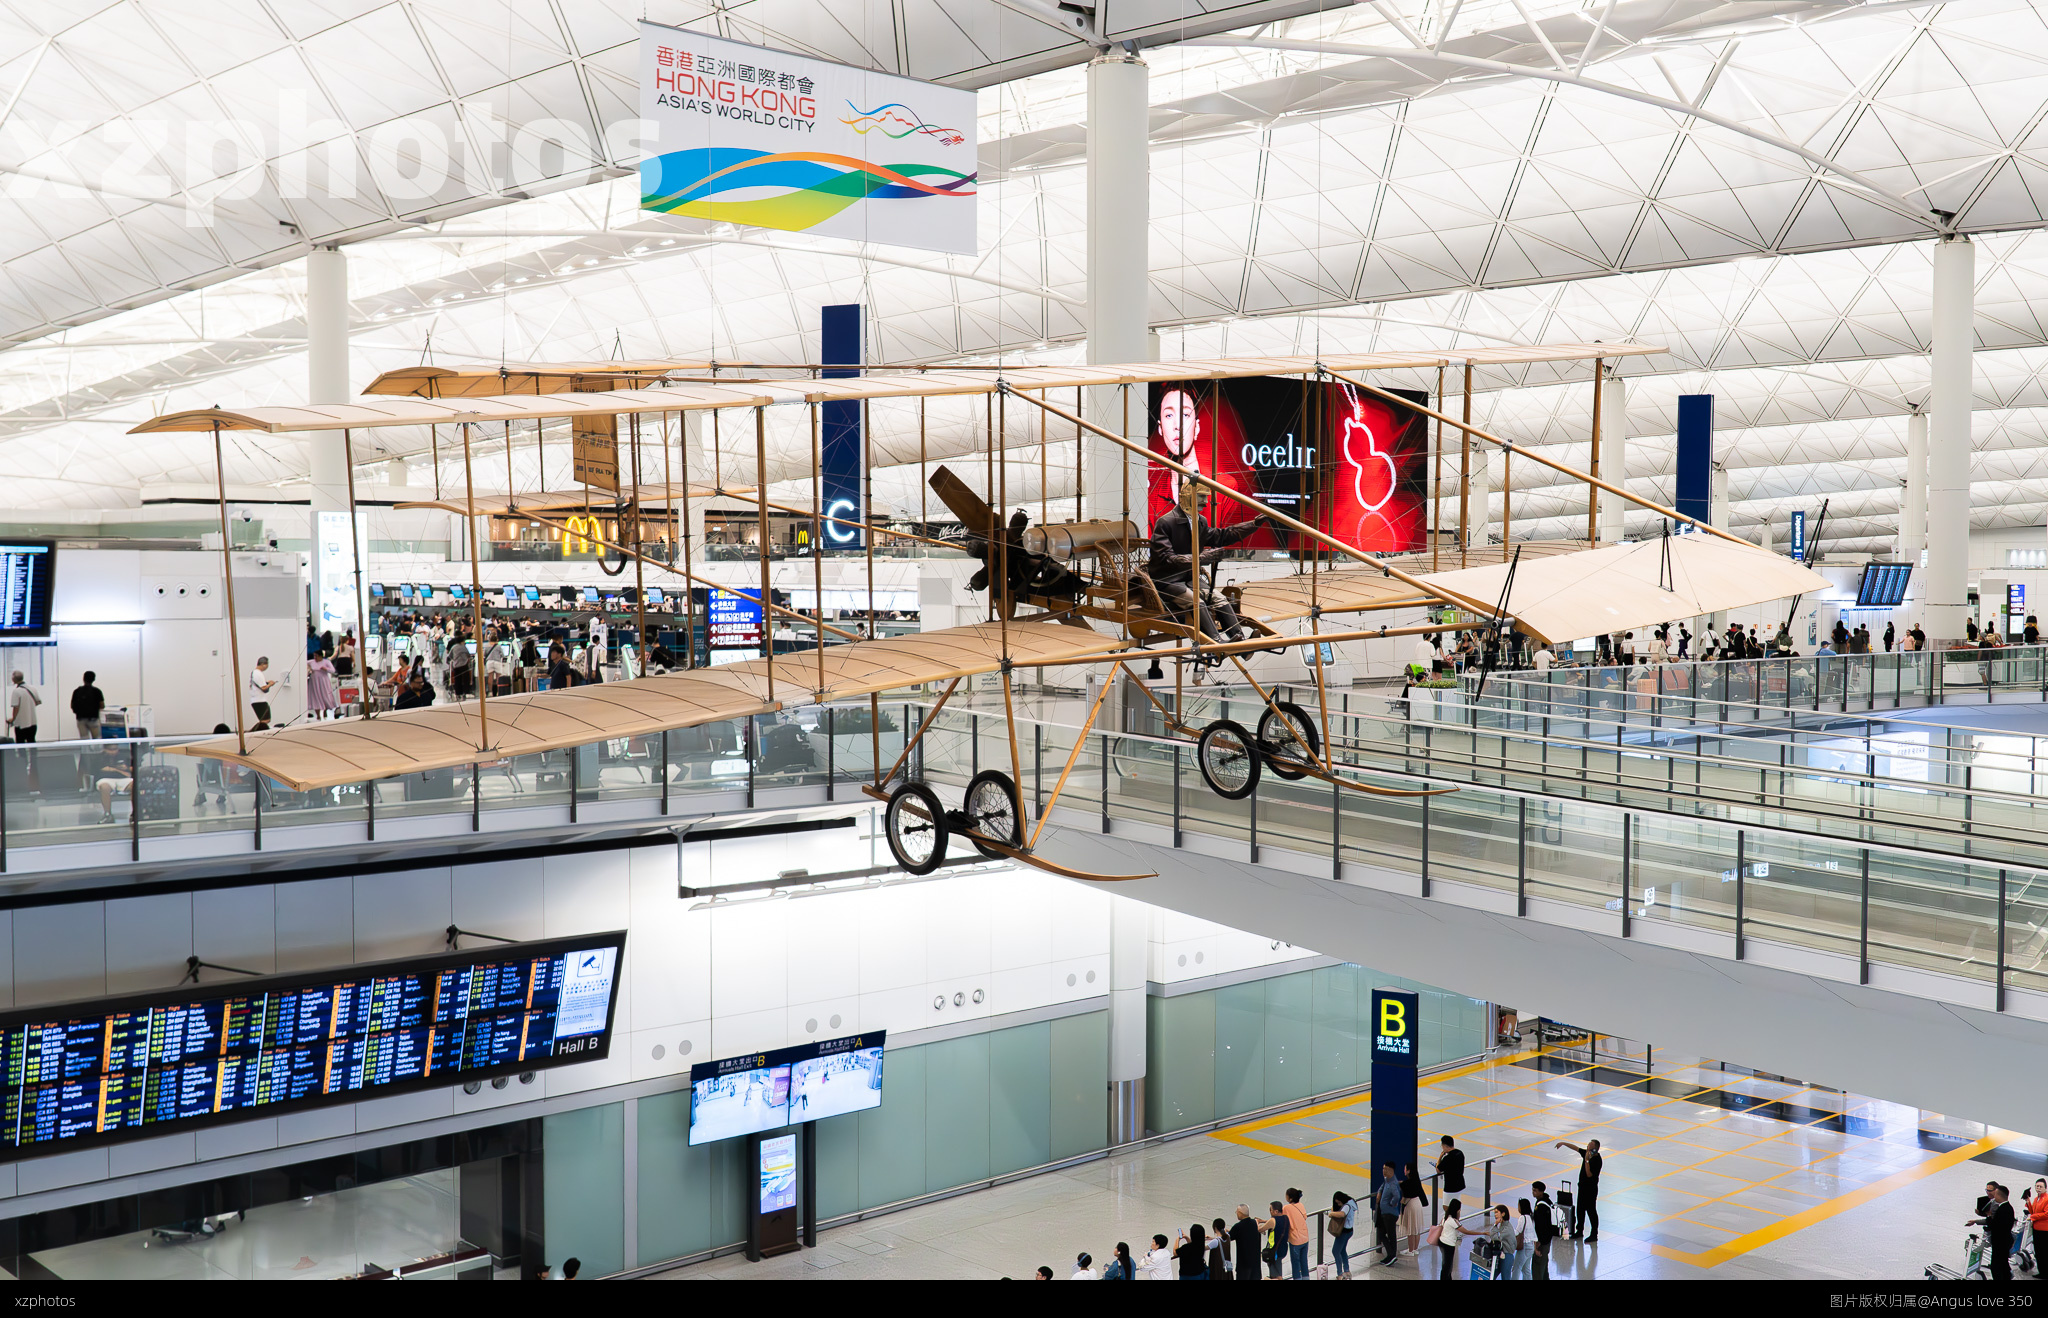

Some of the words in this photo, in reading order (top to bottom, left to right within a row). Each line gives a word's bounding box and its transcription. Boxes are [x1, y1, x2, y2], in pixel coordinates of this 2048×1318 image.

[656, 46, 815, 94] 香港亞洲國際都會
[656, 68, 735, 104] HONG
[742, 85, 816, 118] KONG
[656, 94, 712, 114] ASIA'S
[716, 104, 775, 126] WORLD
[778, 116, 815, 133] CITY
[827, 500, 855, 542] C
[1381, 998, 1406, 1037] B
[559, 1039, 584, 1055] Hall
[588, 1037, 598, 1050] B
[854, 1038, 862, 1048] A
[1376, 1036, 1410, 1047] 接機大堂
[1377, 1044, 1398, 1052] Arrivals
[758, 1055, 765, 1067] B
